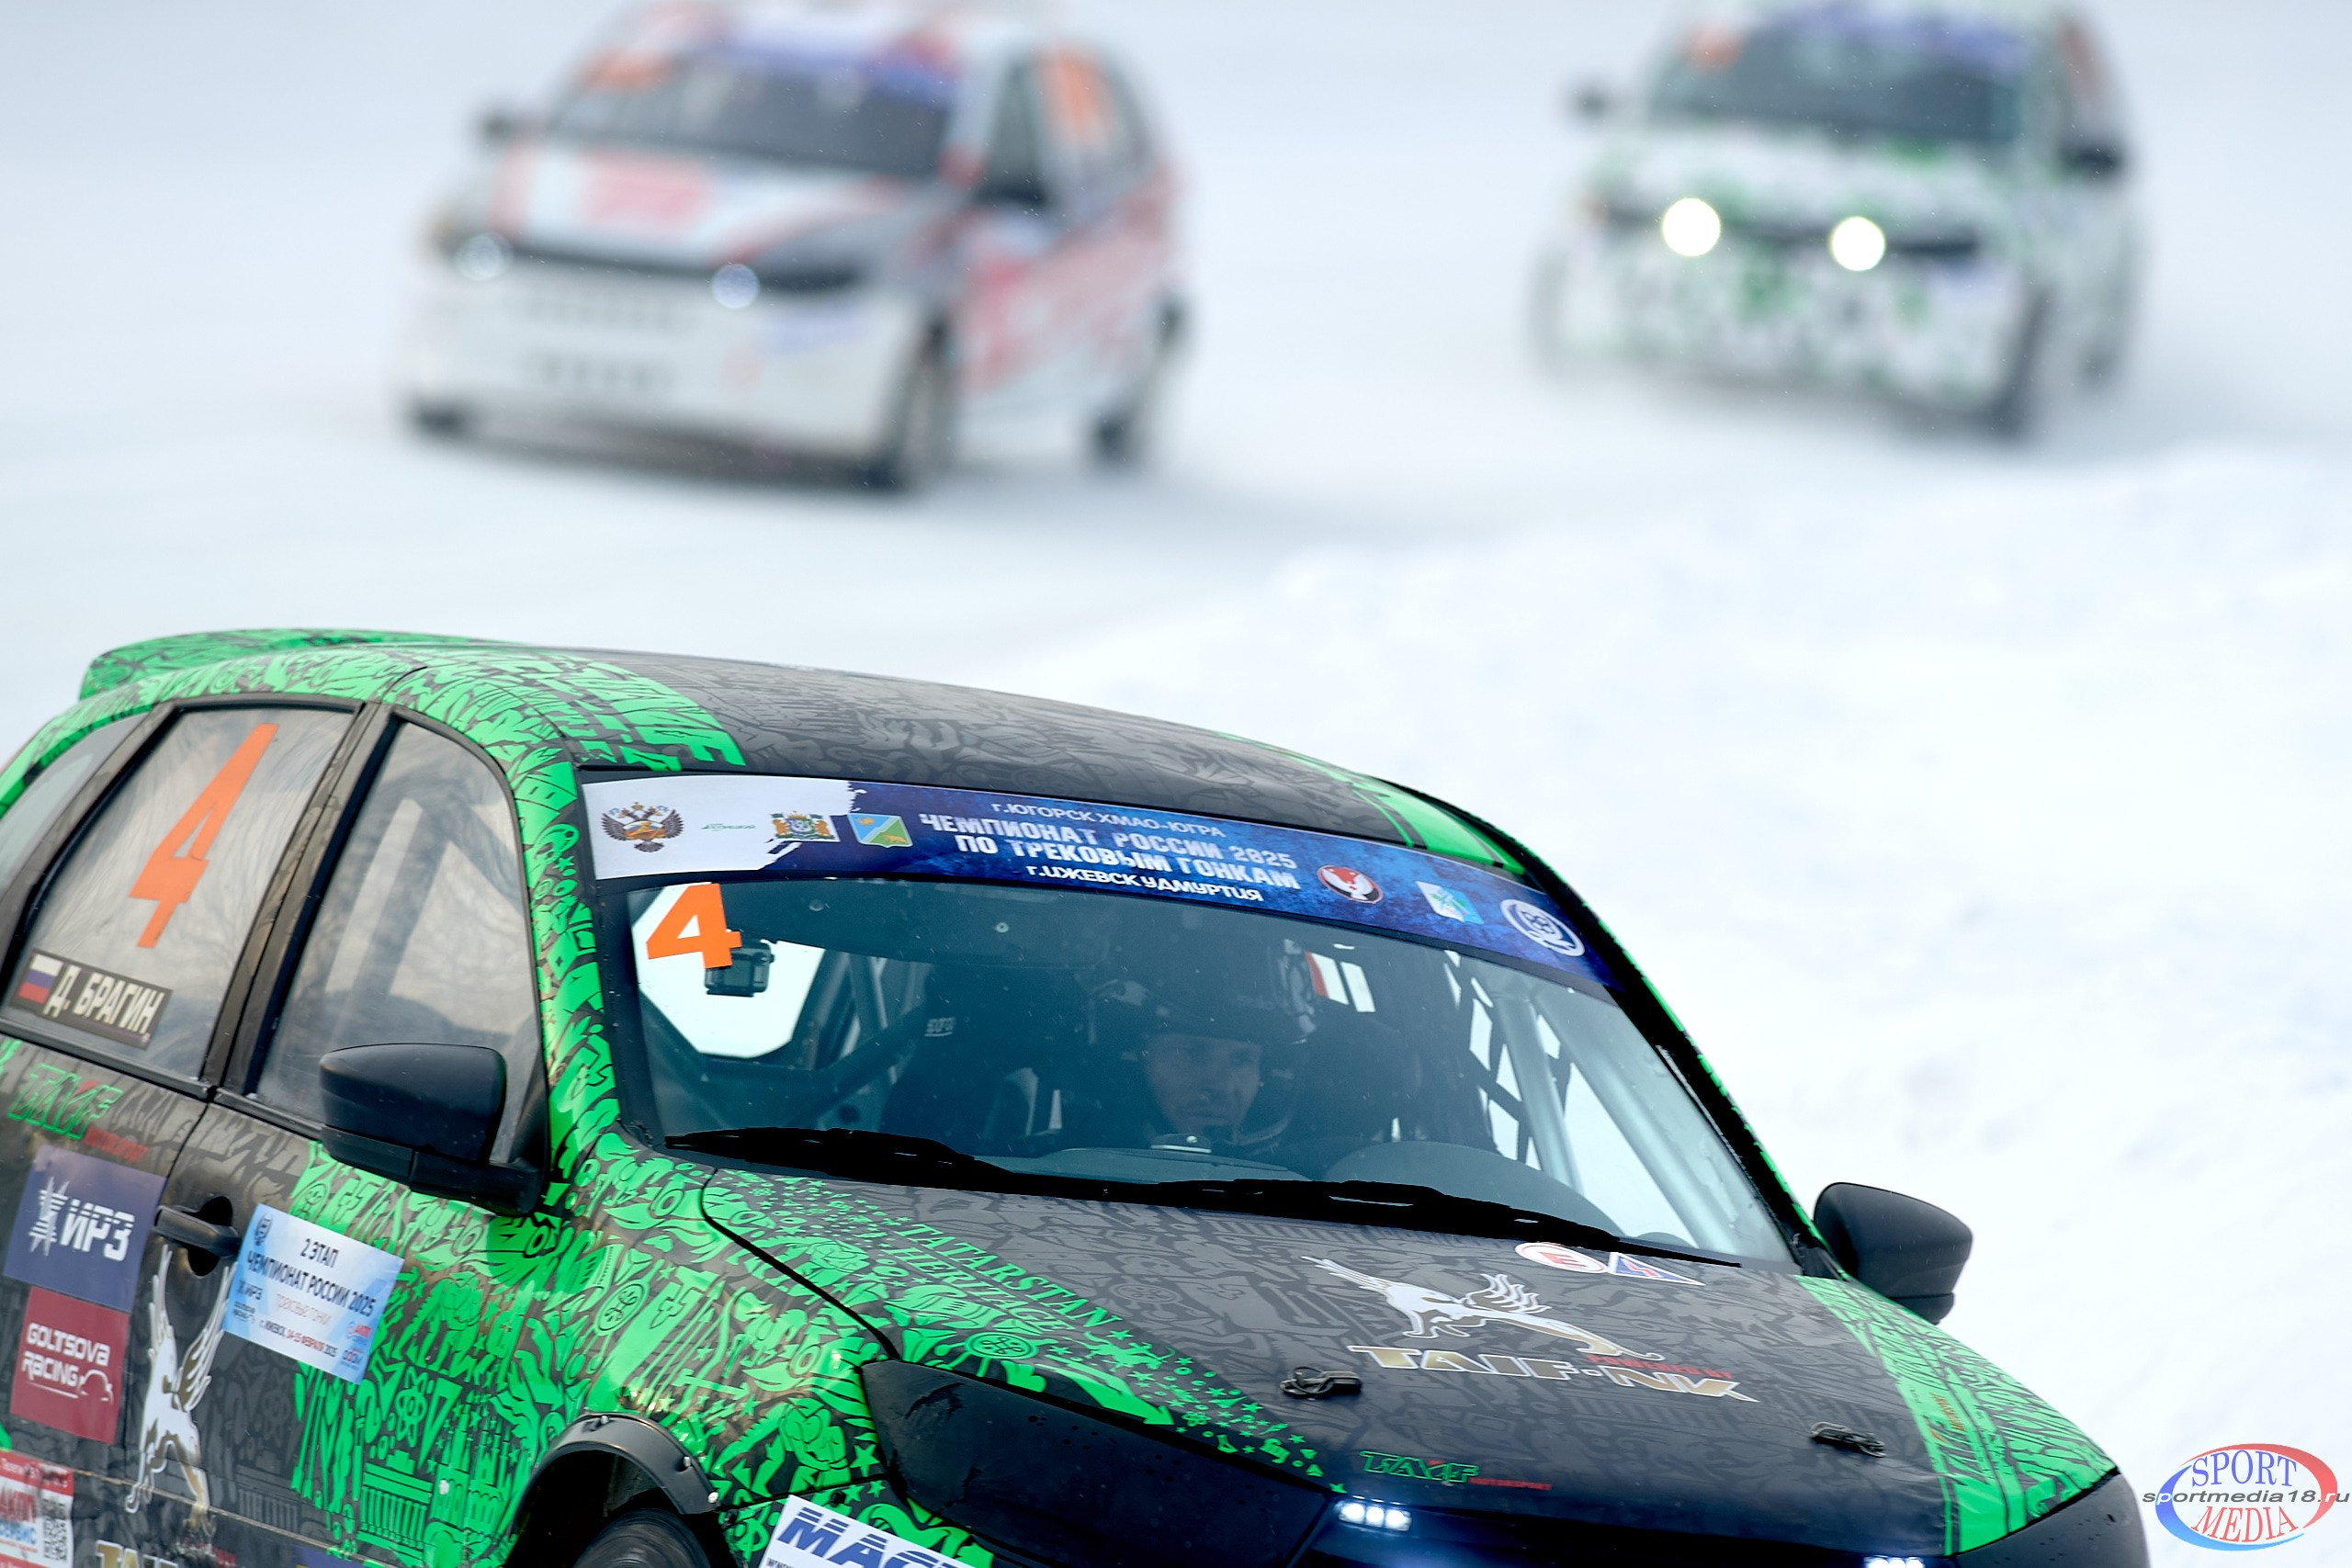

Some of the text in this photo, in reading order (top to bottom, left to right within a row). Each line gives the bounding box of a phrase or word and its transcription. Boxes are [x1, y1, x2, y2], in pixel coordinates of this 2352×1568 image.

[129, 723, 279, 948] 4
[919, 813, 1297, 870] ЧЕМПИОНАТ РОССИИ 2025
[991, 803, 1227, 838] г.ЮГОРСК ХМАО-ЮГРА
[956, 834, 1301, 890] ПО ТРЕКОВЫМ ГОНКАМ
[1143, 874, 1264, 902] УДМУРТИЯ
[646, 882, 741, 969] 4
[44, 965, 165, 1034] Д. БРАГИН
[60, 1199, 135, 1261] ИРЗ
[300, 1238, 340, 1268] 2 ЭТАП
[246, 1250, 377, 1317] ЧЕМПИОНАТ РОССИИ 2025
[881, 1247, 1077, 1330] HERITAGE
[894, 1224, 1123, 1327] TATARSTAN
[22, 1350, 79, 1387] RACING
[28, 1323, 110, 1366] GOLTSOVA
